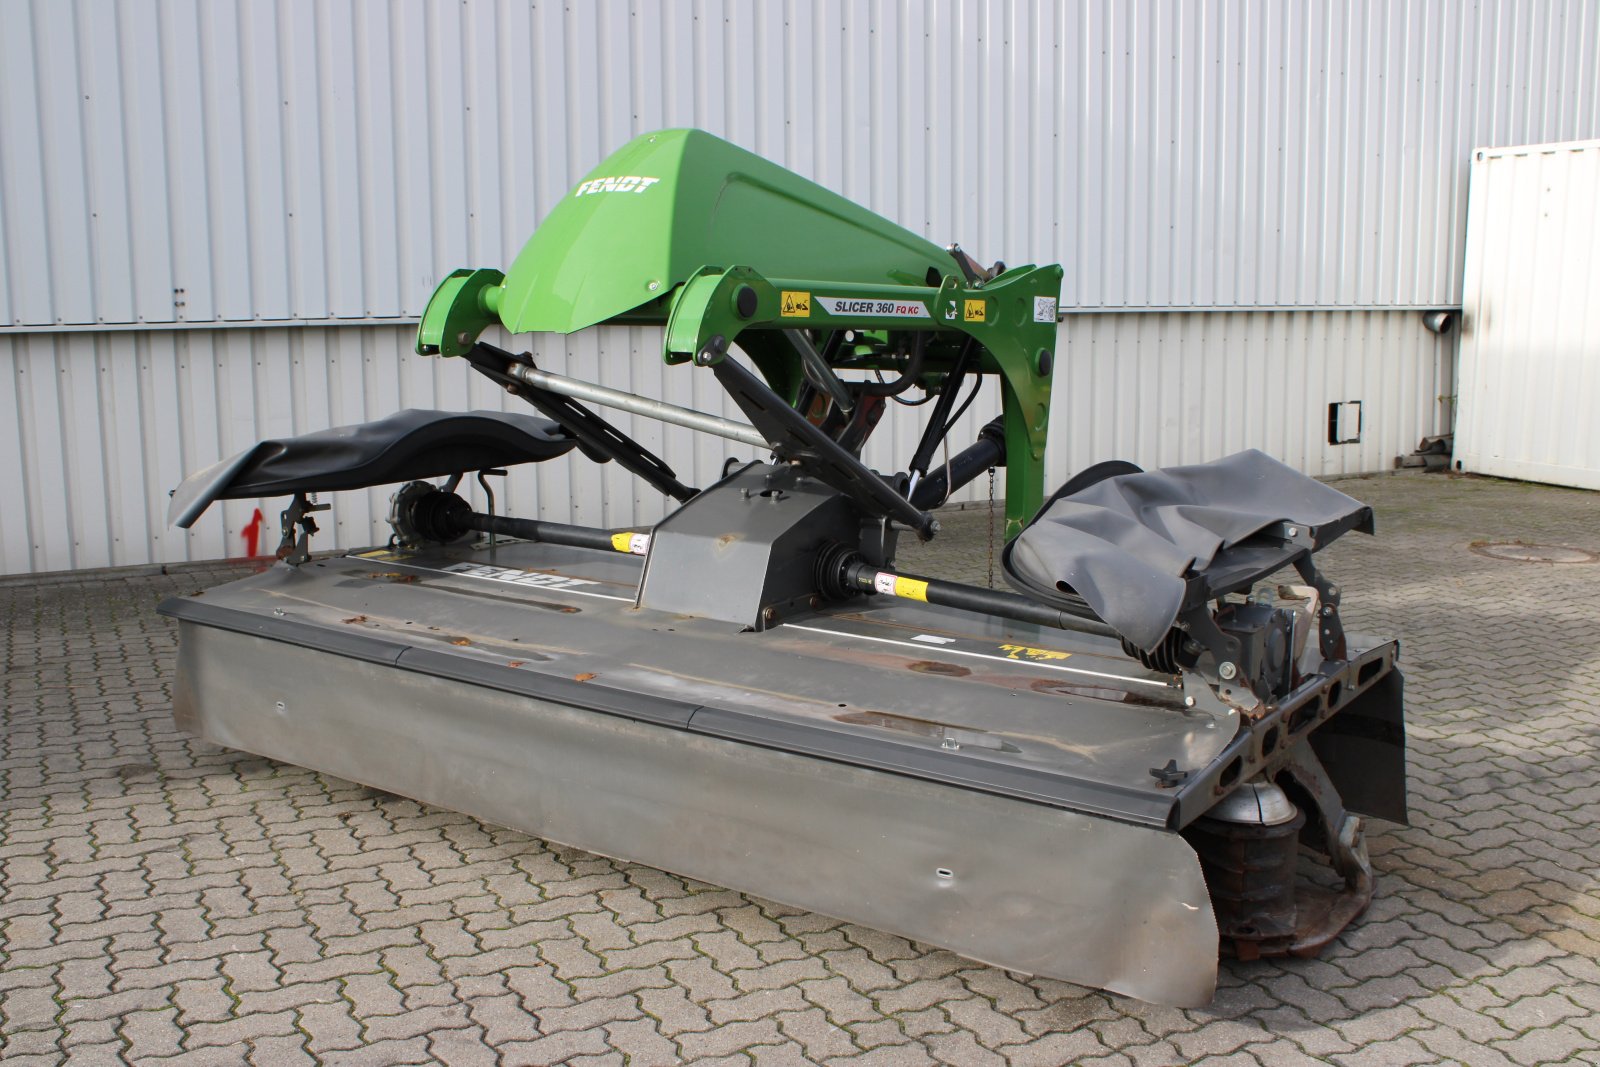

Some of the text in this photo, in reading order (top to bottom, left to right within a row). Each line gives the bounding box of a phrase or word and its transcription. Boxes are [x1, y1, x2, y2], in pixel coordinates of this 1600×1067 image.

[575, 175, 660, 197] FENDT
[834, 301, 919, 314] SLICER 360 FQ KC
[441, 562, 602, 588] FENDT
